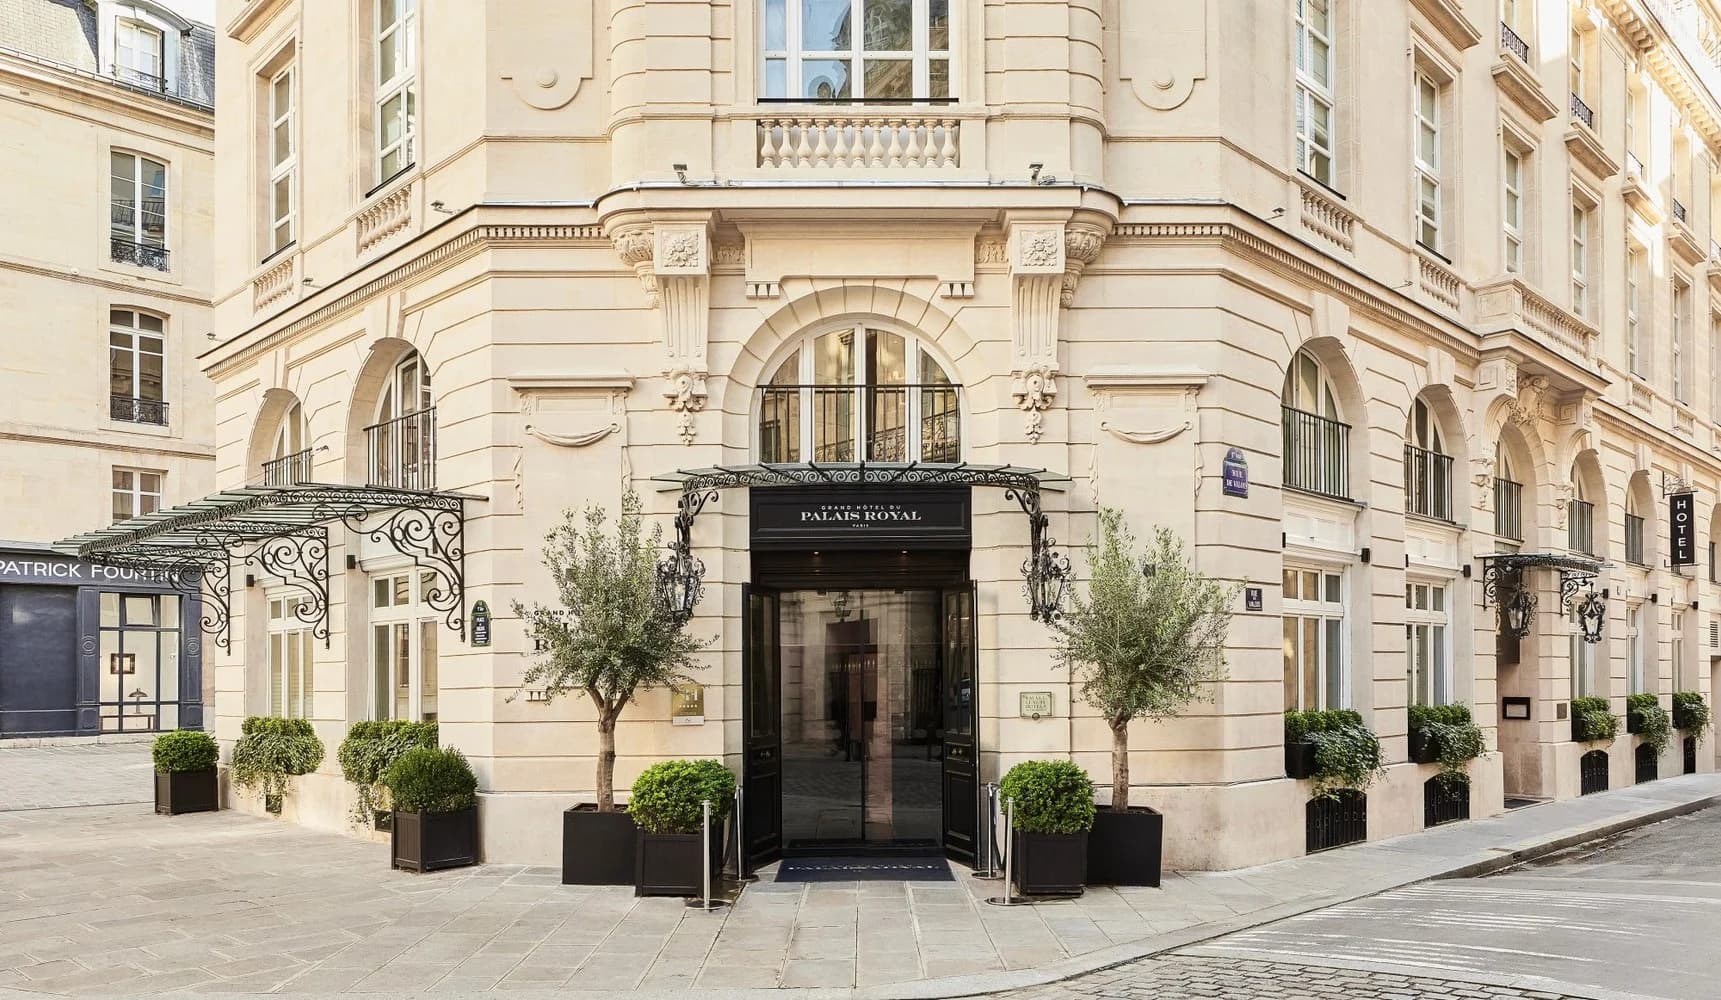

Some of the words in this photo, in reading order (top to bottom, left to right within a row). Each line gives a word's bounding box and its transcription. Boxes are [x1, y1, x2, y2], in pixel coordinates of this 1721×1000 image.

[856, 503, 885, 511] HÔTEL
[800, 510, 861, 521] PALAIS
[864, 510, 922, 521] ROYAL
[1676, 499, 1688, 559] HOTEL
